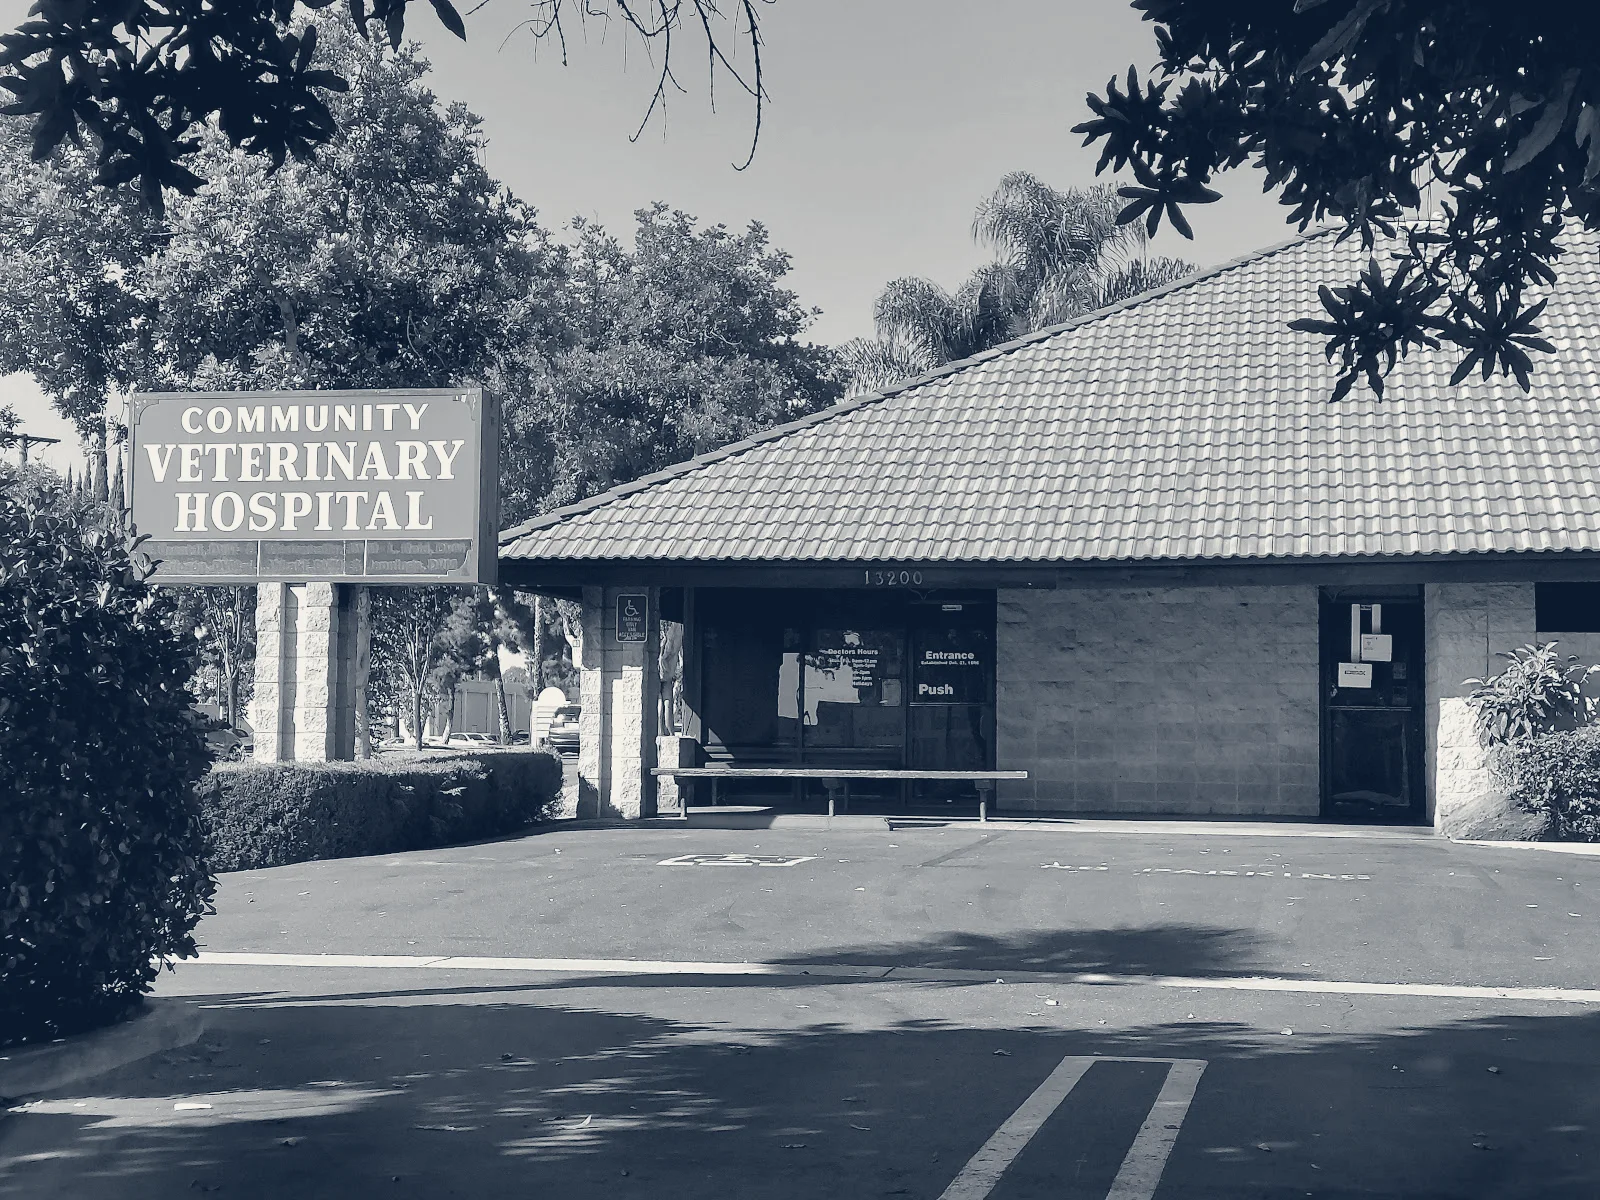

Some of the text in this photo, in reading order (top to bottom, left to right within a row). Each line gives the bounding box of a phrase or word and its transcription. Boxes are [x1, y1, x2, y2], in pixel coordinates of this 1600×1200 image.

[180, 402, 429, 435] COMMUNITY
[142, 439, 465, 483] VETERINARY
[173, 489, 433, 533] HOSPITAL
[864, 570, 923, 586] 13200
[925, 650, 975, 660] Entrance
[918, 683, 954, 695] Push
